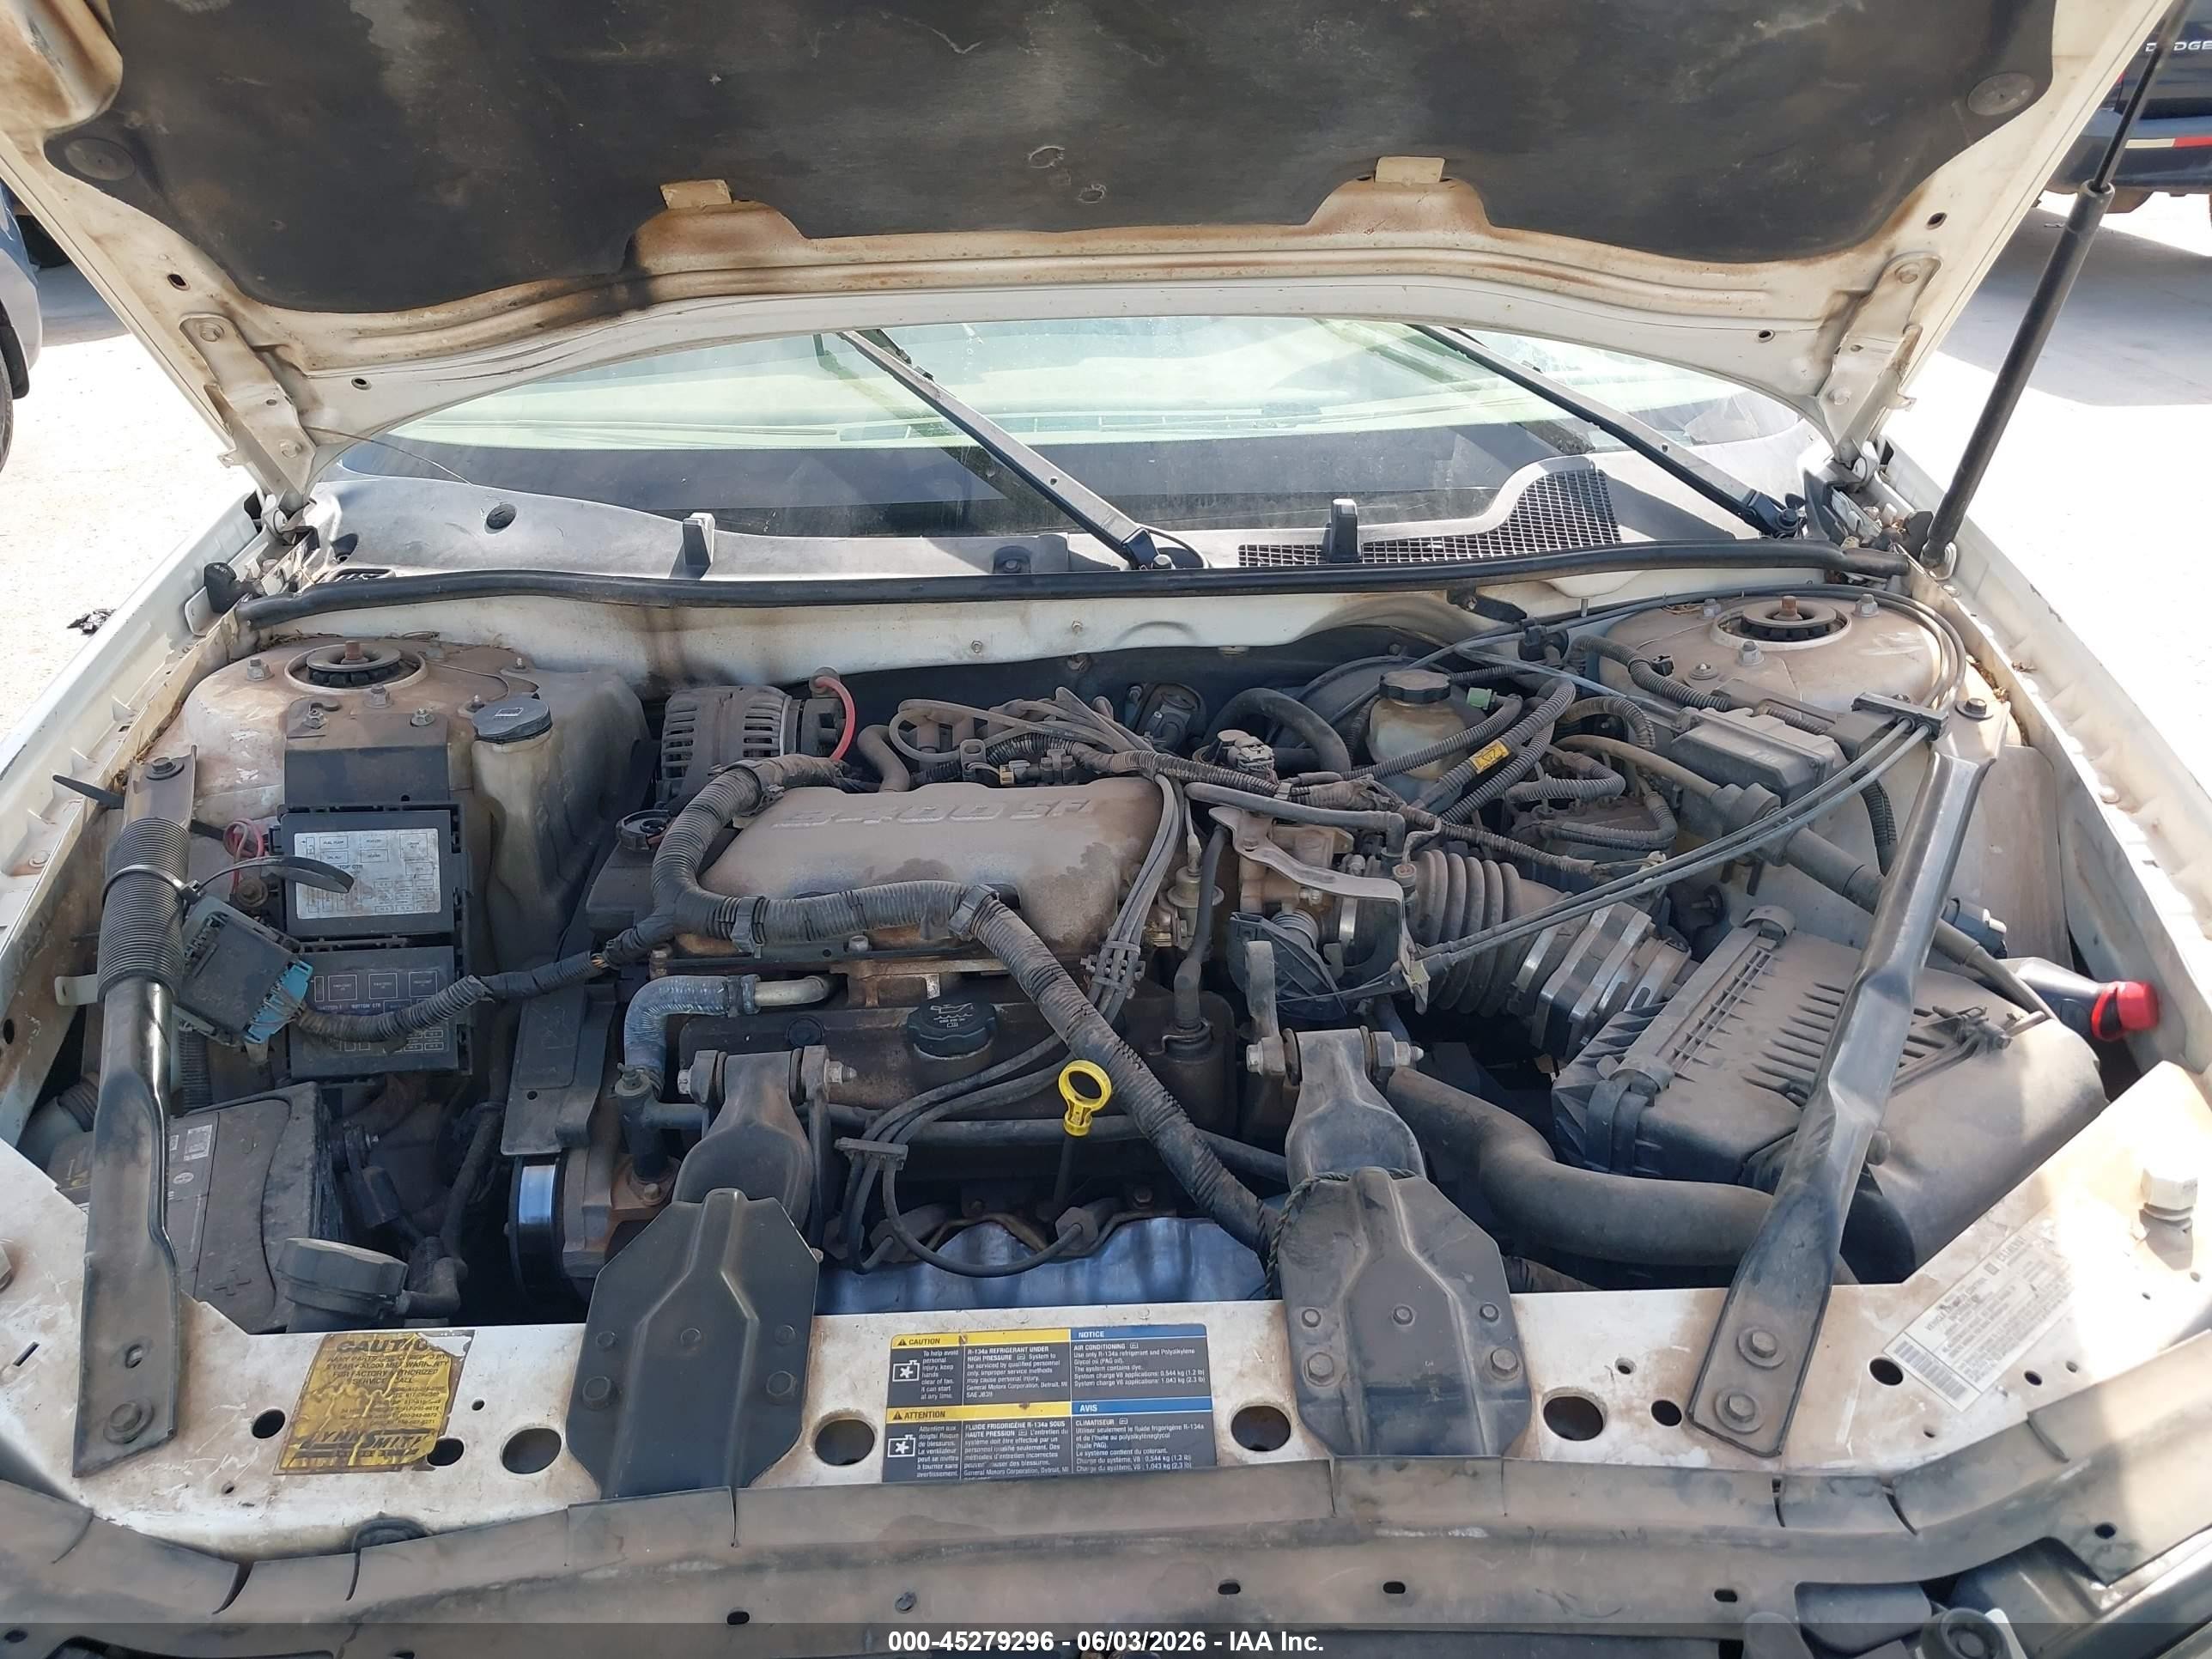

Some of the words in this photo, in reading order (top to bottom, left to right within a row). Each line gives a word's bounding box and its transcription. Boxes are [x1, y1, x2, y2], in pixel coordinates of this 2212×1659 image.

[2145, 40, 2212, 52] DDGE
[337, 1339, 429, 1352] CAUTIO
[1161, 1348, 1195, 1357] Polyalkylene
[1008, 1360, 1032, 1369] qualified
[1099, 1357, 1113, 1365] (PAG
[1176, 1369, 1185, 1377] kg
[1079, 1404, 1097, 1413] AVIS
[904, 1411, 946, 1419] ATTENTION
